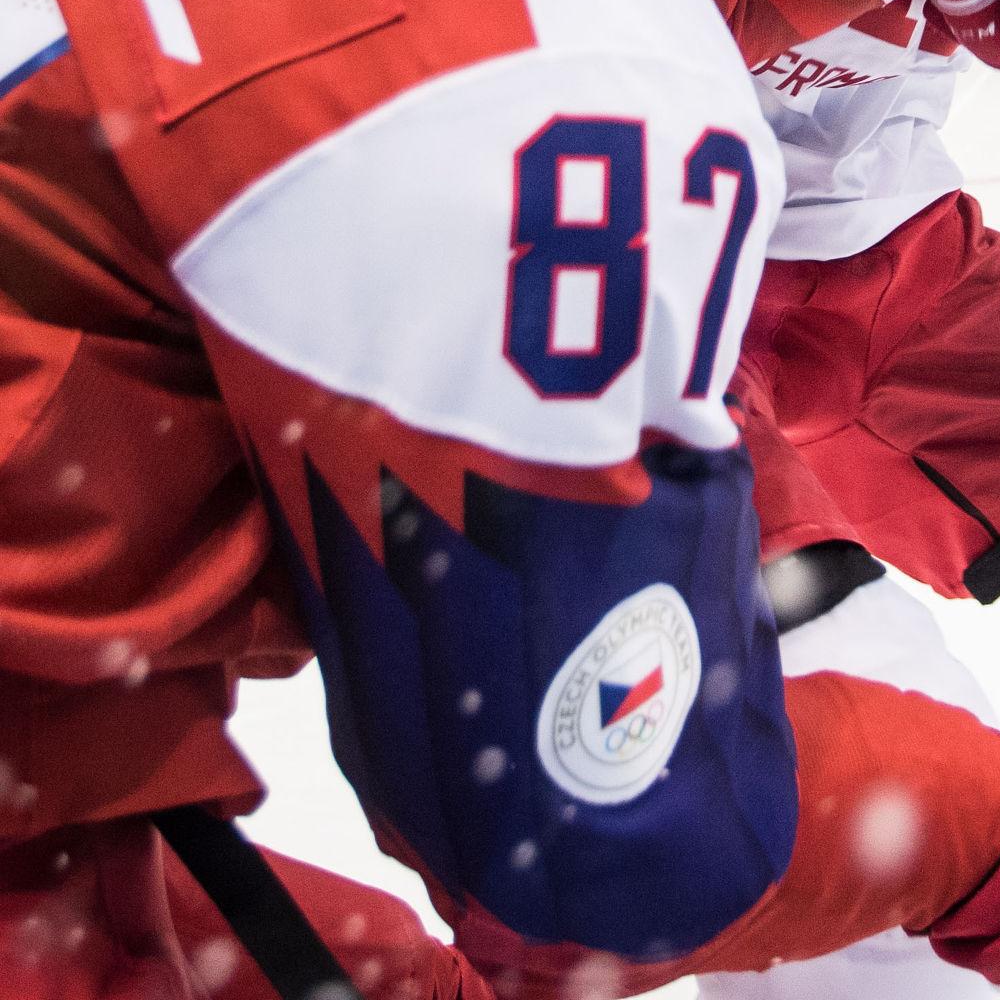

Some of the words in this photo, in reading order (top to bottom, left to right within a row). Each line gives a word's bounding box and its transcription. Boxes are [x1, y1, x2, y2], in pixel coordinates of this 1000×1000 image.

[502, 113, 759, 402] 87
[558, 670, 589, 751] CZECH
[594, 605, 668, 663] OLYMPIC
